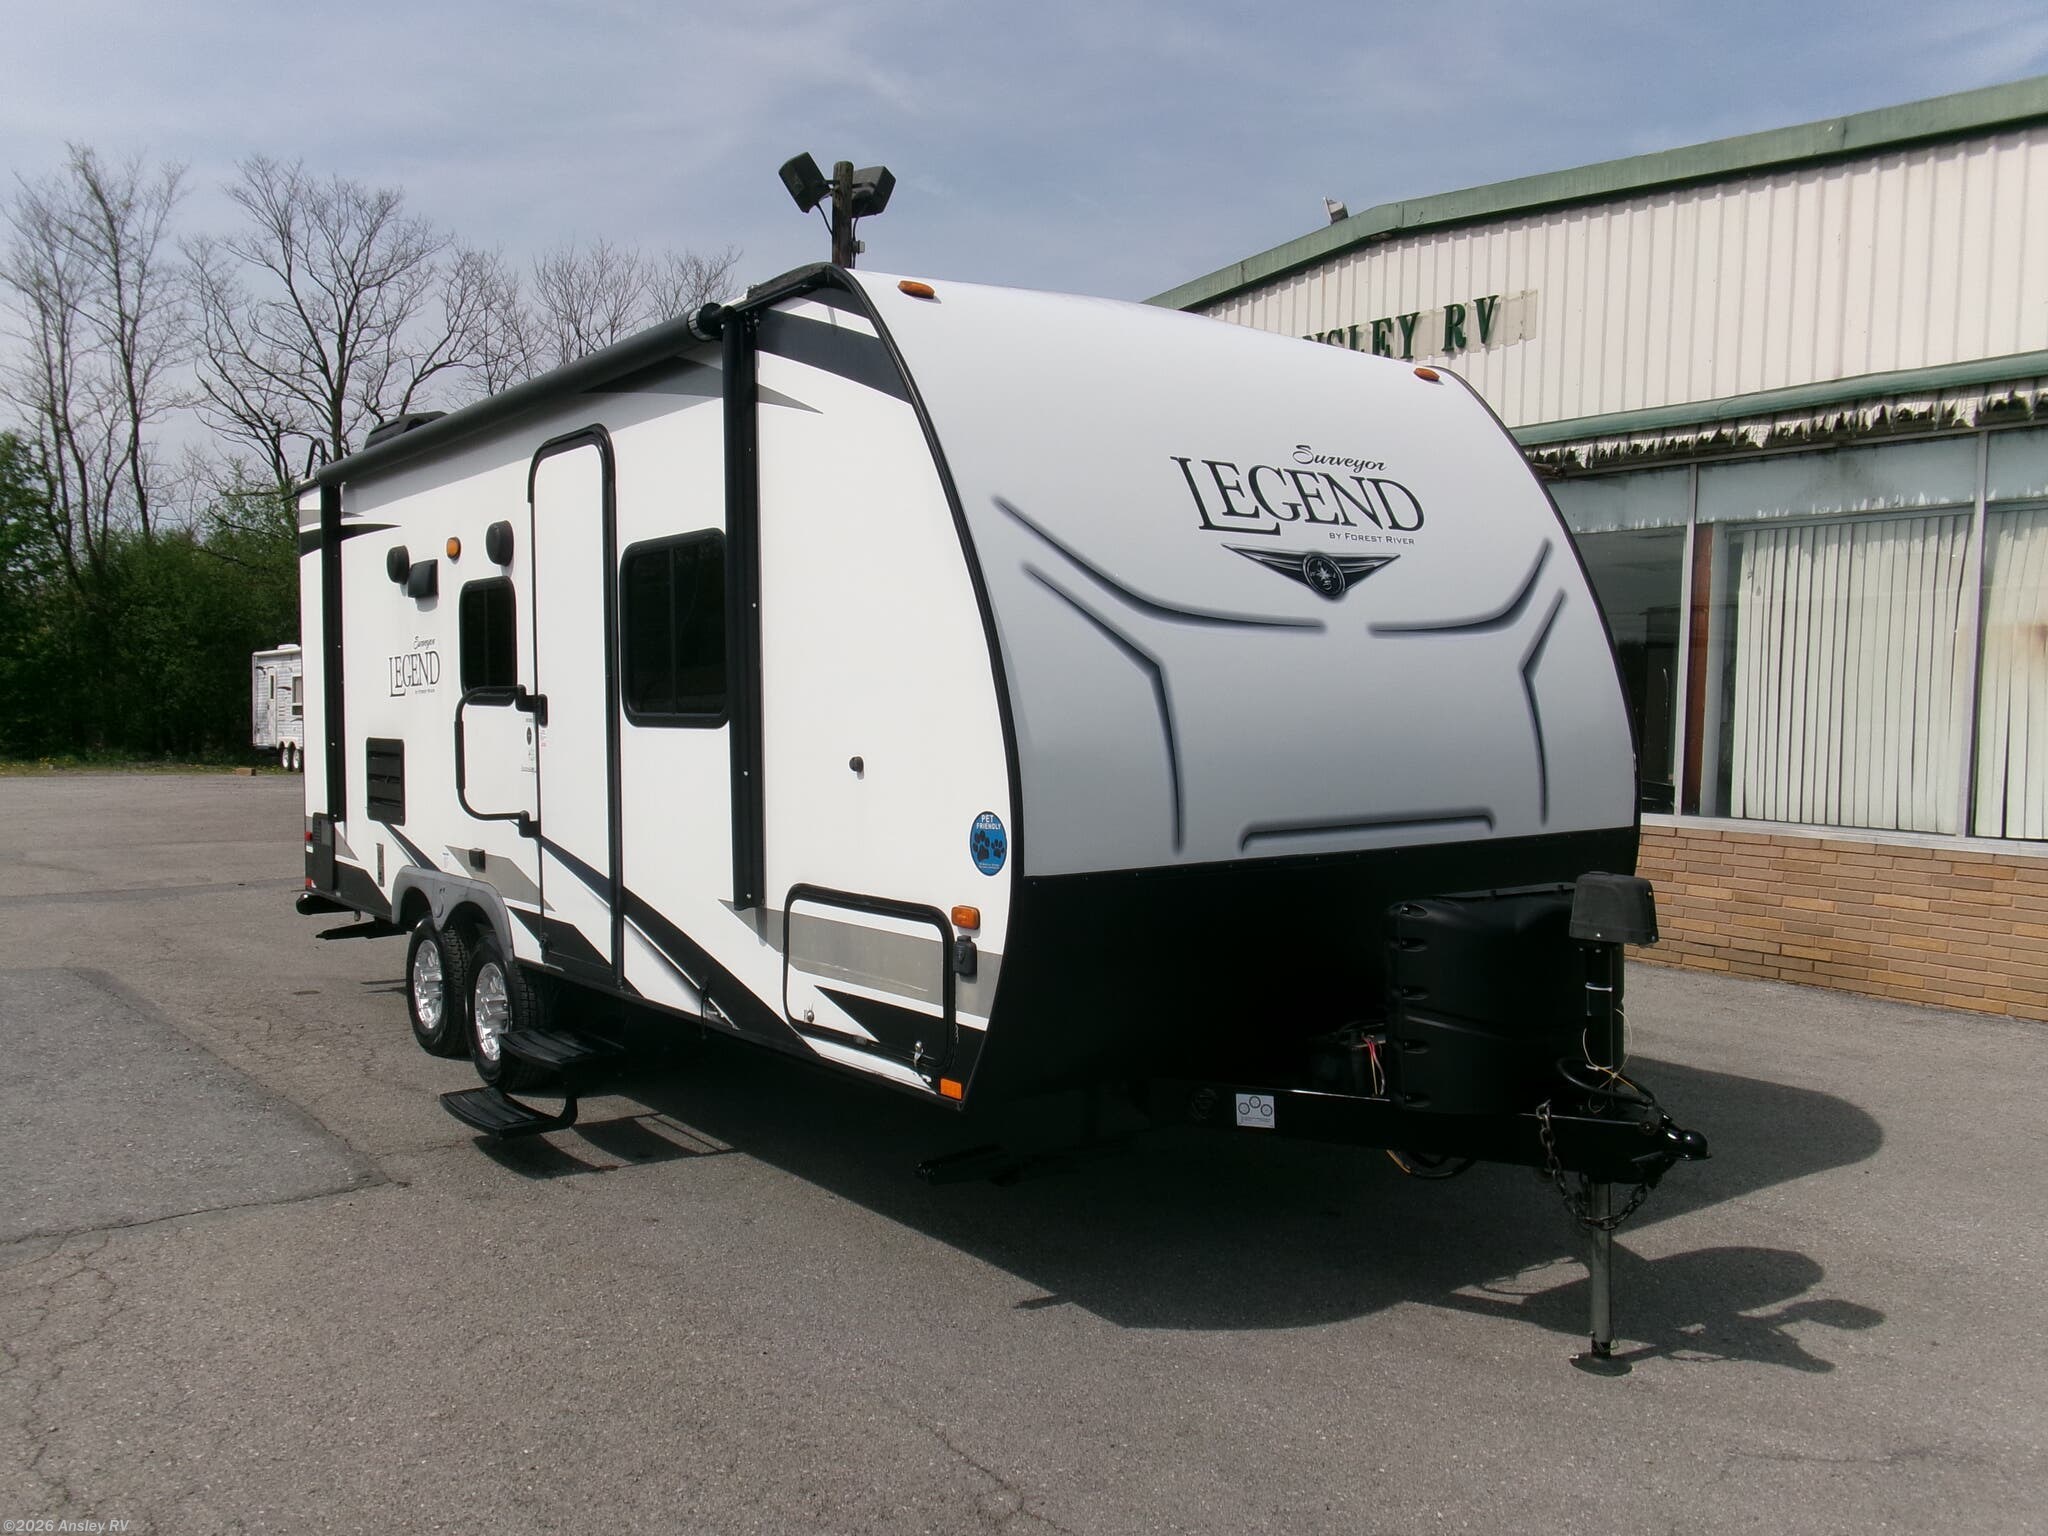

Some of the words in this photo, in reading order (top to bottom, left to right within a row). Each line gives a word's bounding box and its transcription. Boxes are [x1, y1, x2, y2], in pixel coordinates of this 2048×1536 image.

[1303, 312, 1420, 359] LEY
[1442, 295, 1499, 351] RV
[1292, 445, 1387, 473] Surveyor
[1170, 456, 1425, 536] LEGEND
[1345, 532, 1382, 543] FOREST
[1385, 535, 1415, 545] RIVER
[389, 650, 440, 697] LEGEND
[976, 822, 1001, 830] FRIENDLY
[981, 814, 994, 823] PET
